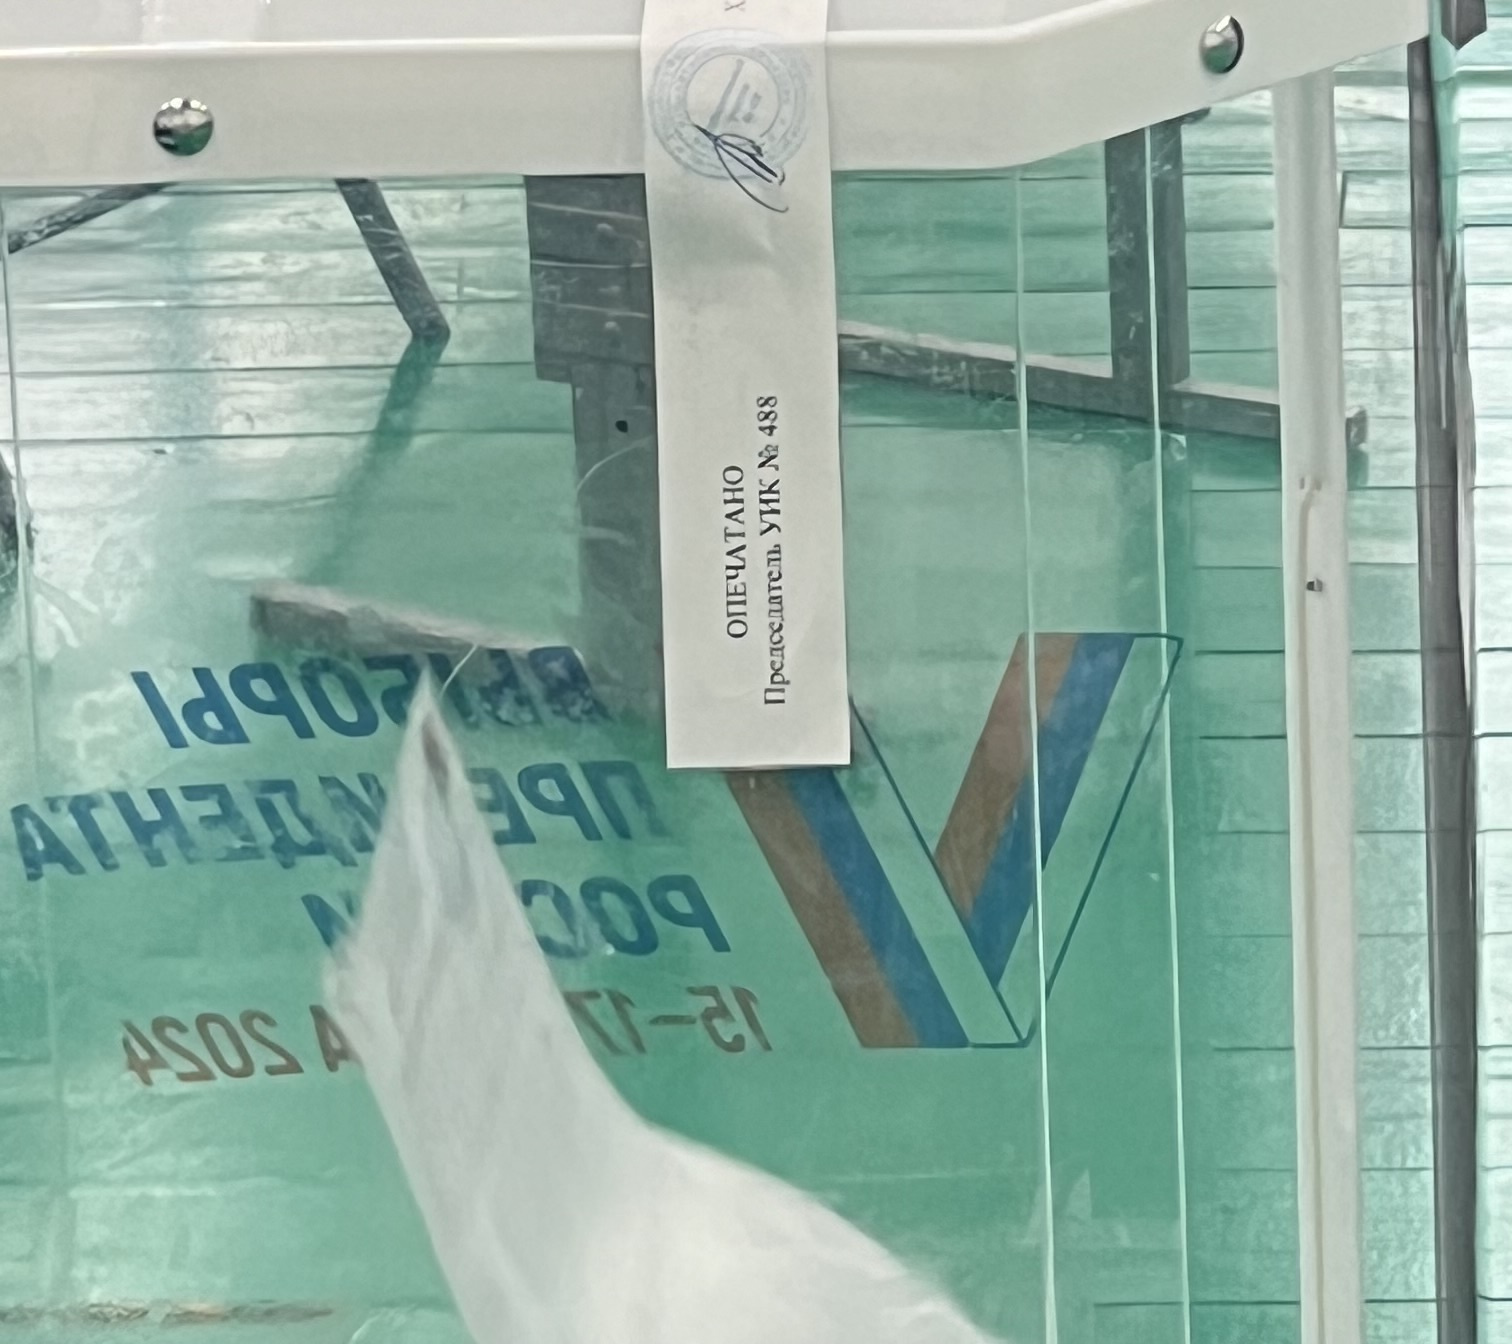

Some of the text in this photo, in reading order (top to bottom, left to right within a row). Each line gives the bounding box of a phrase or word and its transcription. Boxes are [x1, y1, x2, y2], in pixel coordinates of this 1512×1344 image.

[722, 465, 748, 639] ОПЕЧАТАНО
[756, 395, 791, 705] Председатель УИК № 488
